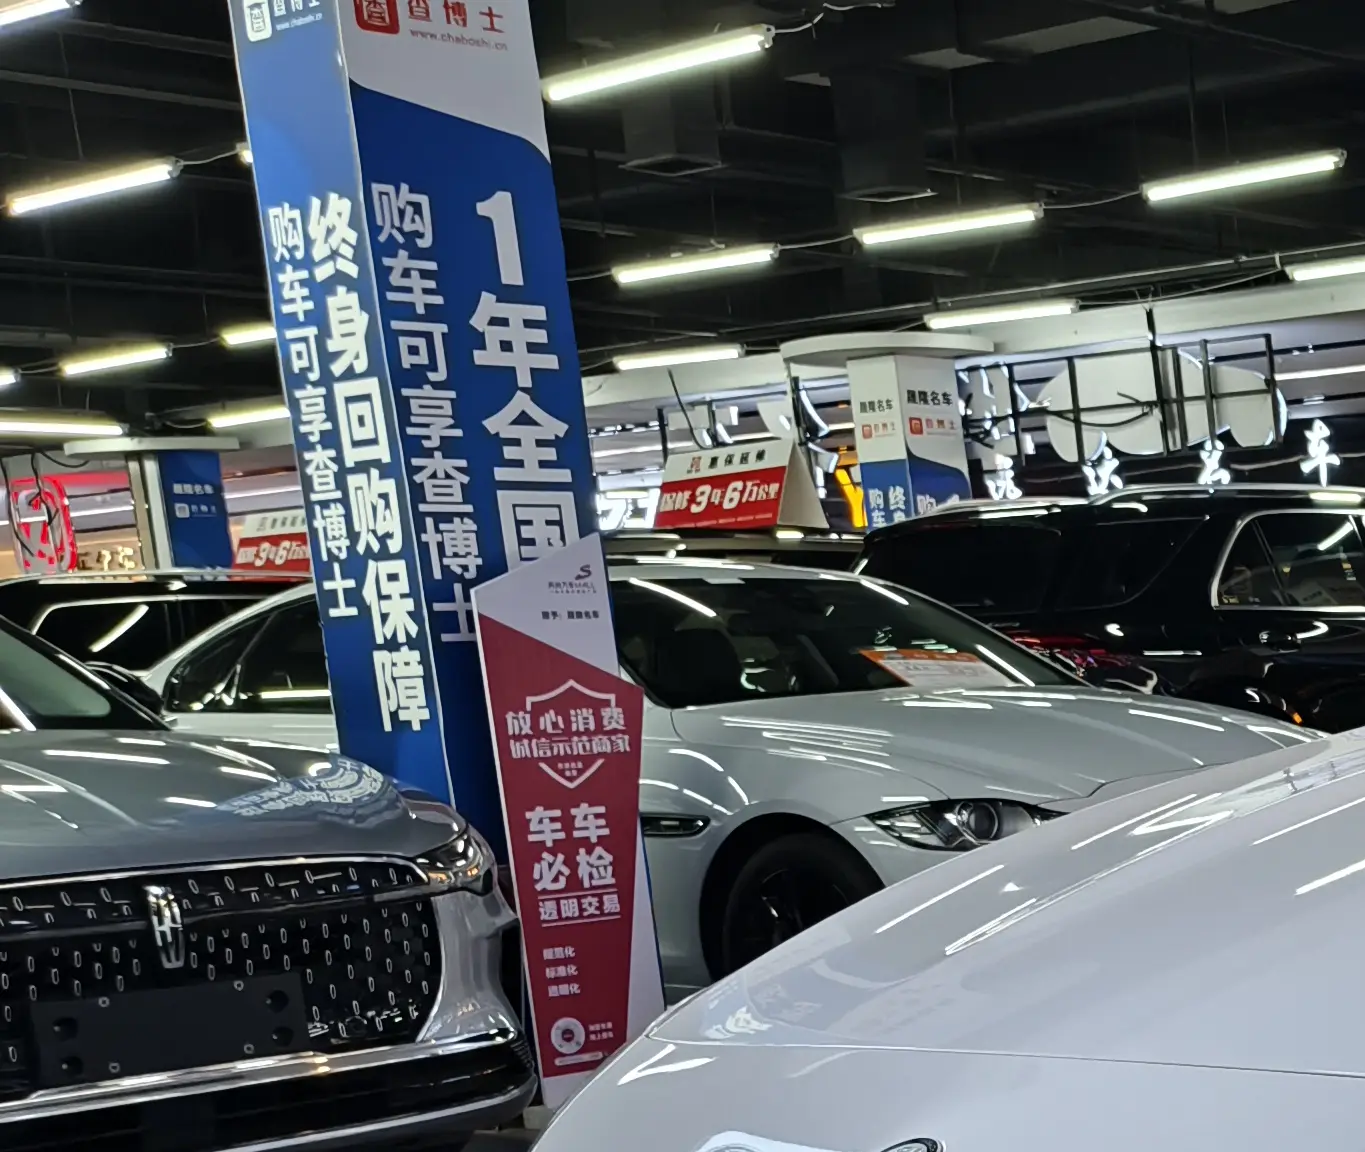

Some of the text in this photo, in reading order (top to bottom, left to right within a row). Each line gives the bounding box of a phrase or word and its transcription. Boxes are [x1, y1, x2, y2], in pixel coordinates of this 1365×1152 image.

[410, 28, 508, 51] www.chaboshi.cn
[267, 202, 359, 618] 购车可享查博士
[308, 192, 431, 733] 终身回购保障
[505, 707, 627, 736] 放心消费
[509, 734, 631, 760] 诚信示范商家
[525, 802, 611, 848] 车车
[532, 845, 617, 893] 必检
[538, 893, 621, 921] 透明交易
